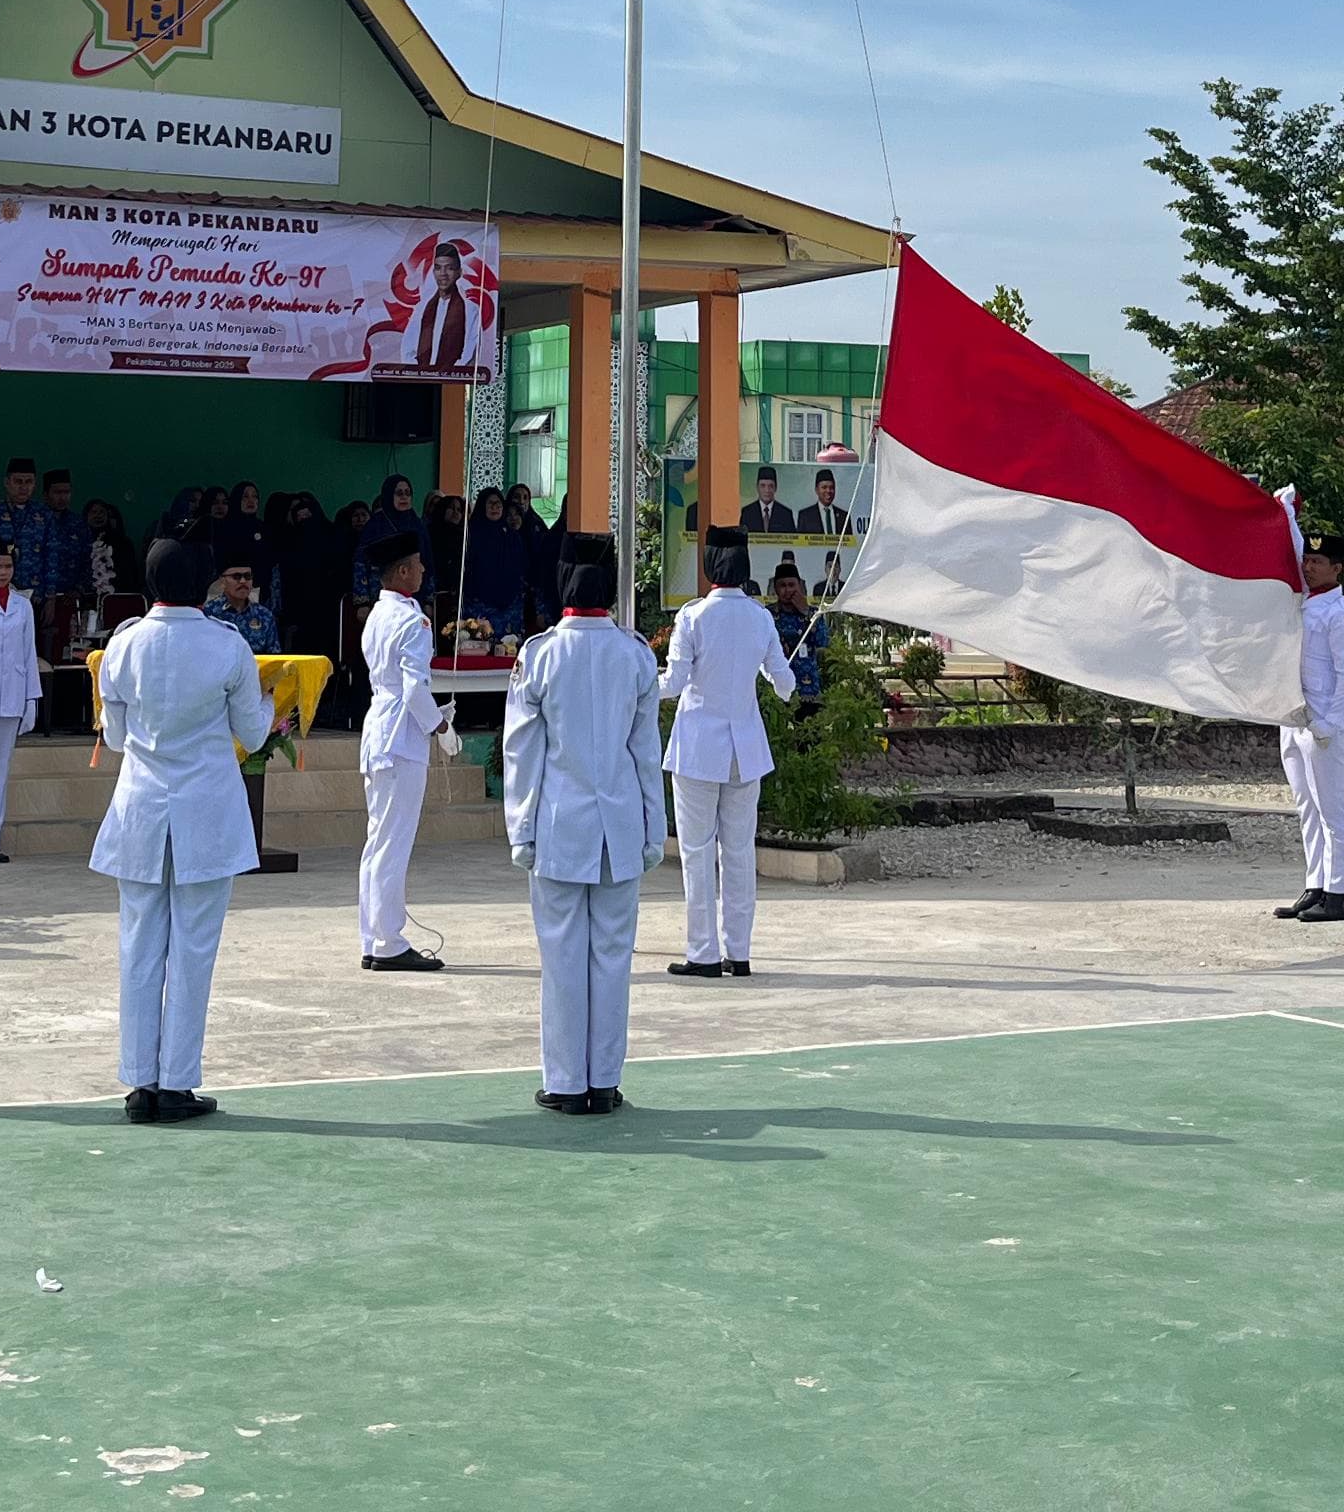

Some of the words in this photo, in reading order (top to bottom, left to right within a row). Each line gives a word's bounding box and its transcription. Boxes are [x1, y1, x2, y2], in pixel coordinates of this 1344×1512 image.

[40, 110, 57, 134] 3
[67, 113, 146, 142] KOTA
[156, 120, 332, 156] PEKANBARU
[48, 203, 99, 221] MAN
[105, 208, 117, 222] 3
[123, 209, 182, 227] KOTA
[188, 212, 319, 234] PEKANBARU
[111, 229, 216, 255] Memperingati
[222, 234, 261, 253] Hari
[41, 248, 143, 283] Sumpah
[147, 254, 246, 285] Pemuda
[250, 259, 327, 289] Ke-97
[17, 283, 83, 306] Sempena
[86, 286, 136, 307] HUT
[139, 289, 192, 309] MAN
[194, 290, 207, 310] 3
[210, 292, 246, 312] Kota
[248, 294, 323, 314] Pekanbaru
[118, 317, 126, 328] 3
[188, 321, 214, 332] UAS
[102, 336, 146, 347] Pemudi
[204, 340, 259, 352] Indonesia
[181, 359, 213, 369] Oktober
